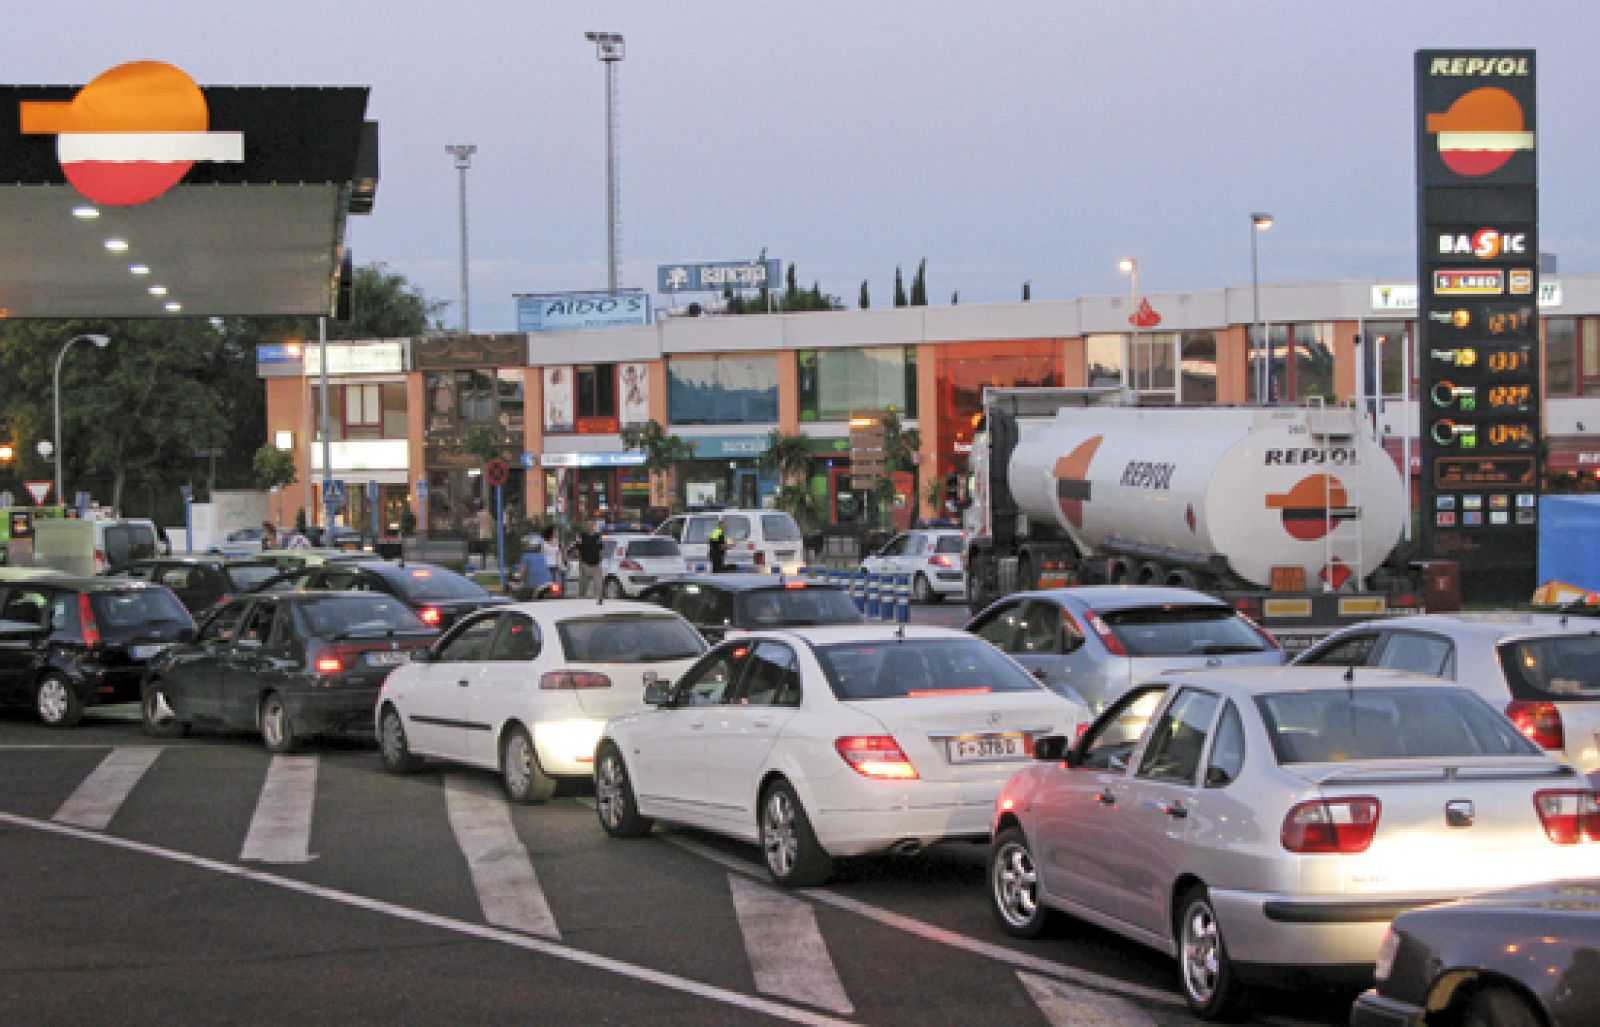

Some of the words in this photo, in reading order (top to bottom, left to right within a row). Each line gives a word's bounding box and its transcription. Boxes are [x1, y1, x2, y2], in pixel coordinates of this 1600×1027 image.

[1430, 57, 1528, 76] REPSOL
[1439, 231, 1525, 257] BASIC
[1265, 447, 1358, 467] REPSOL
